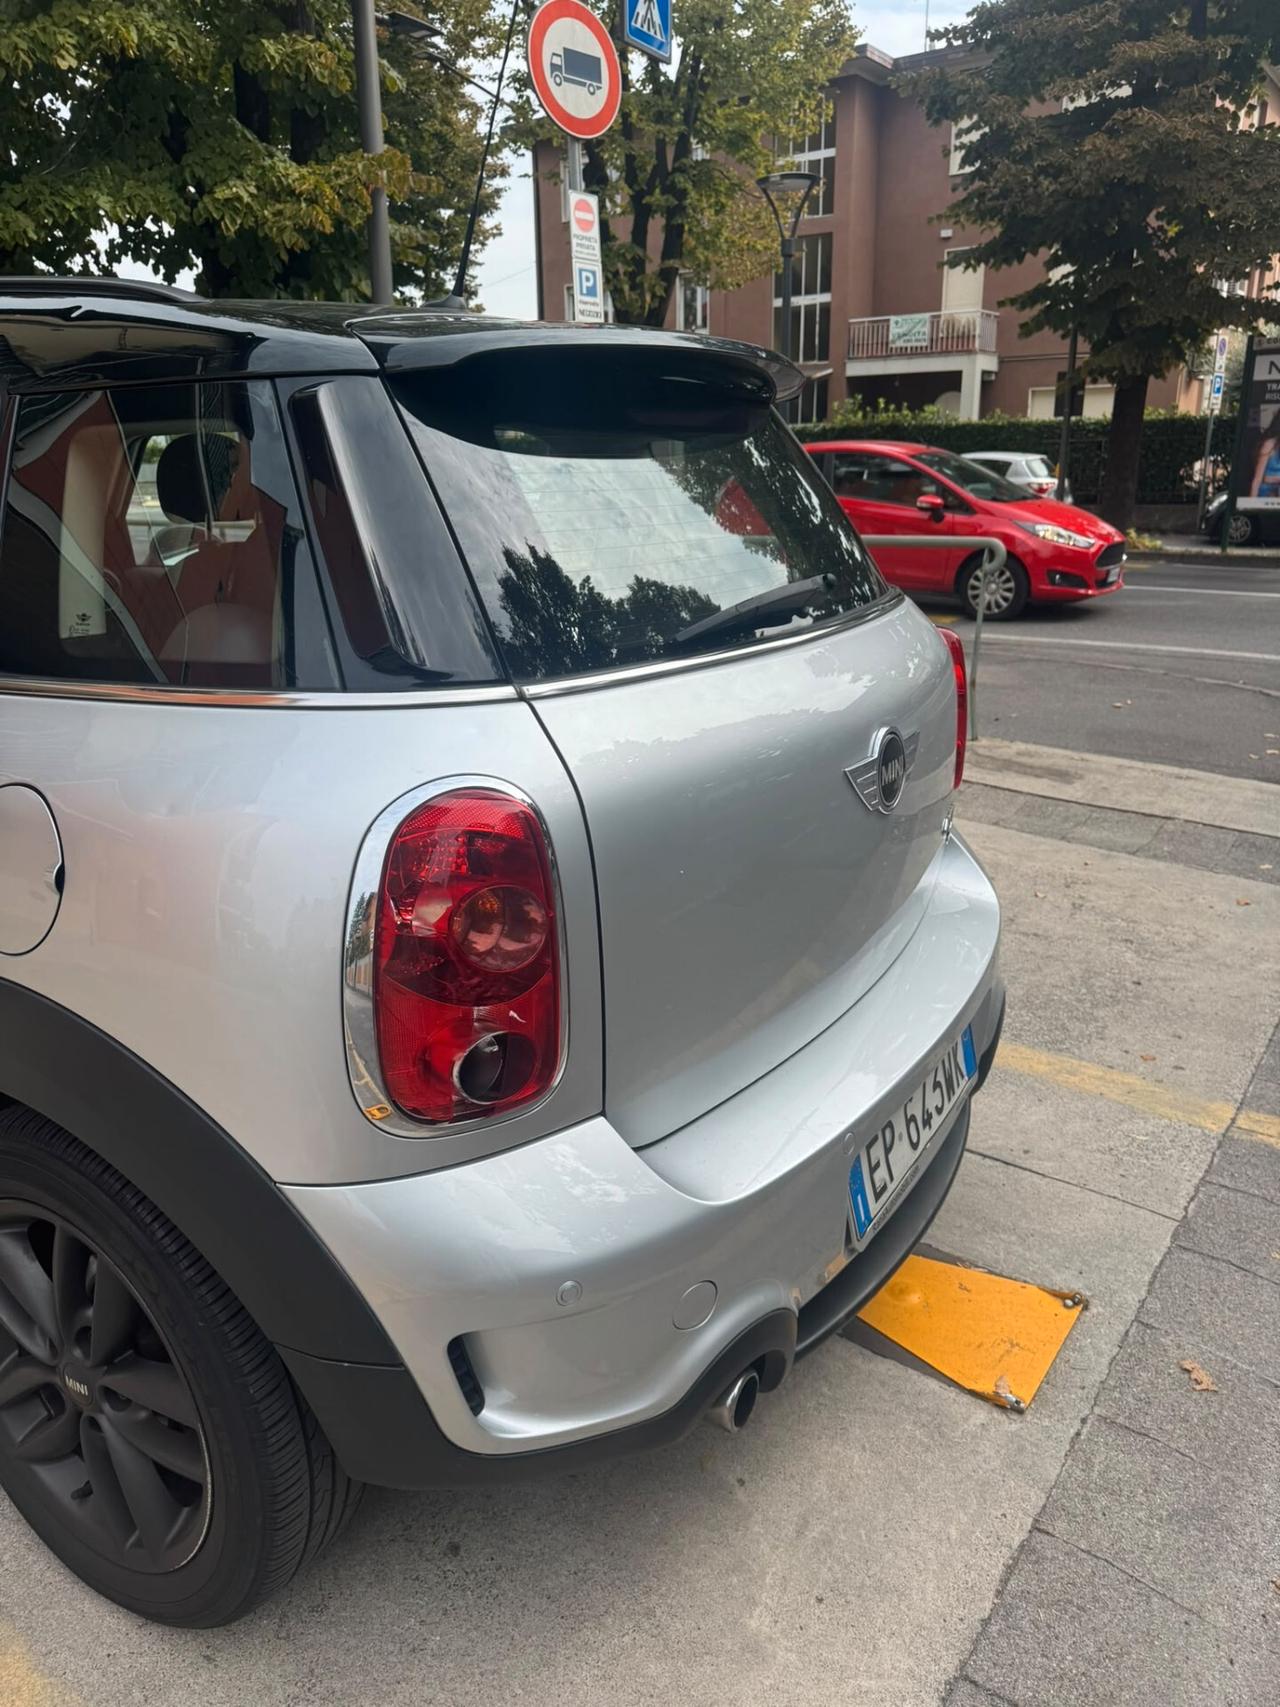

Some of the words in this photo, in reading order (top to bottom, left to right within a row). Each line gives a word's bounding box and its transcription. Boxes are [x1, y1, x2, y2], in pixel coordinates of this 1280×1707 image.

[581, 270, 594, 294] P
[865, 1119, 895, 1204] EP
[904, 1039, 965, 1151] 645WK
[65, 1375, 89, 1396] MINI
